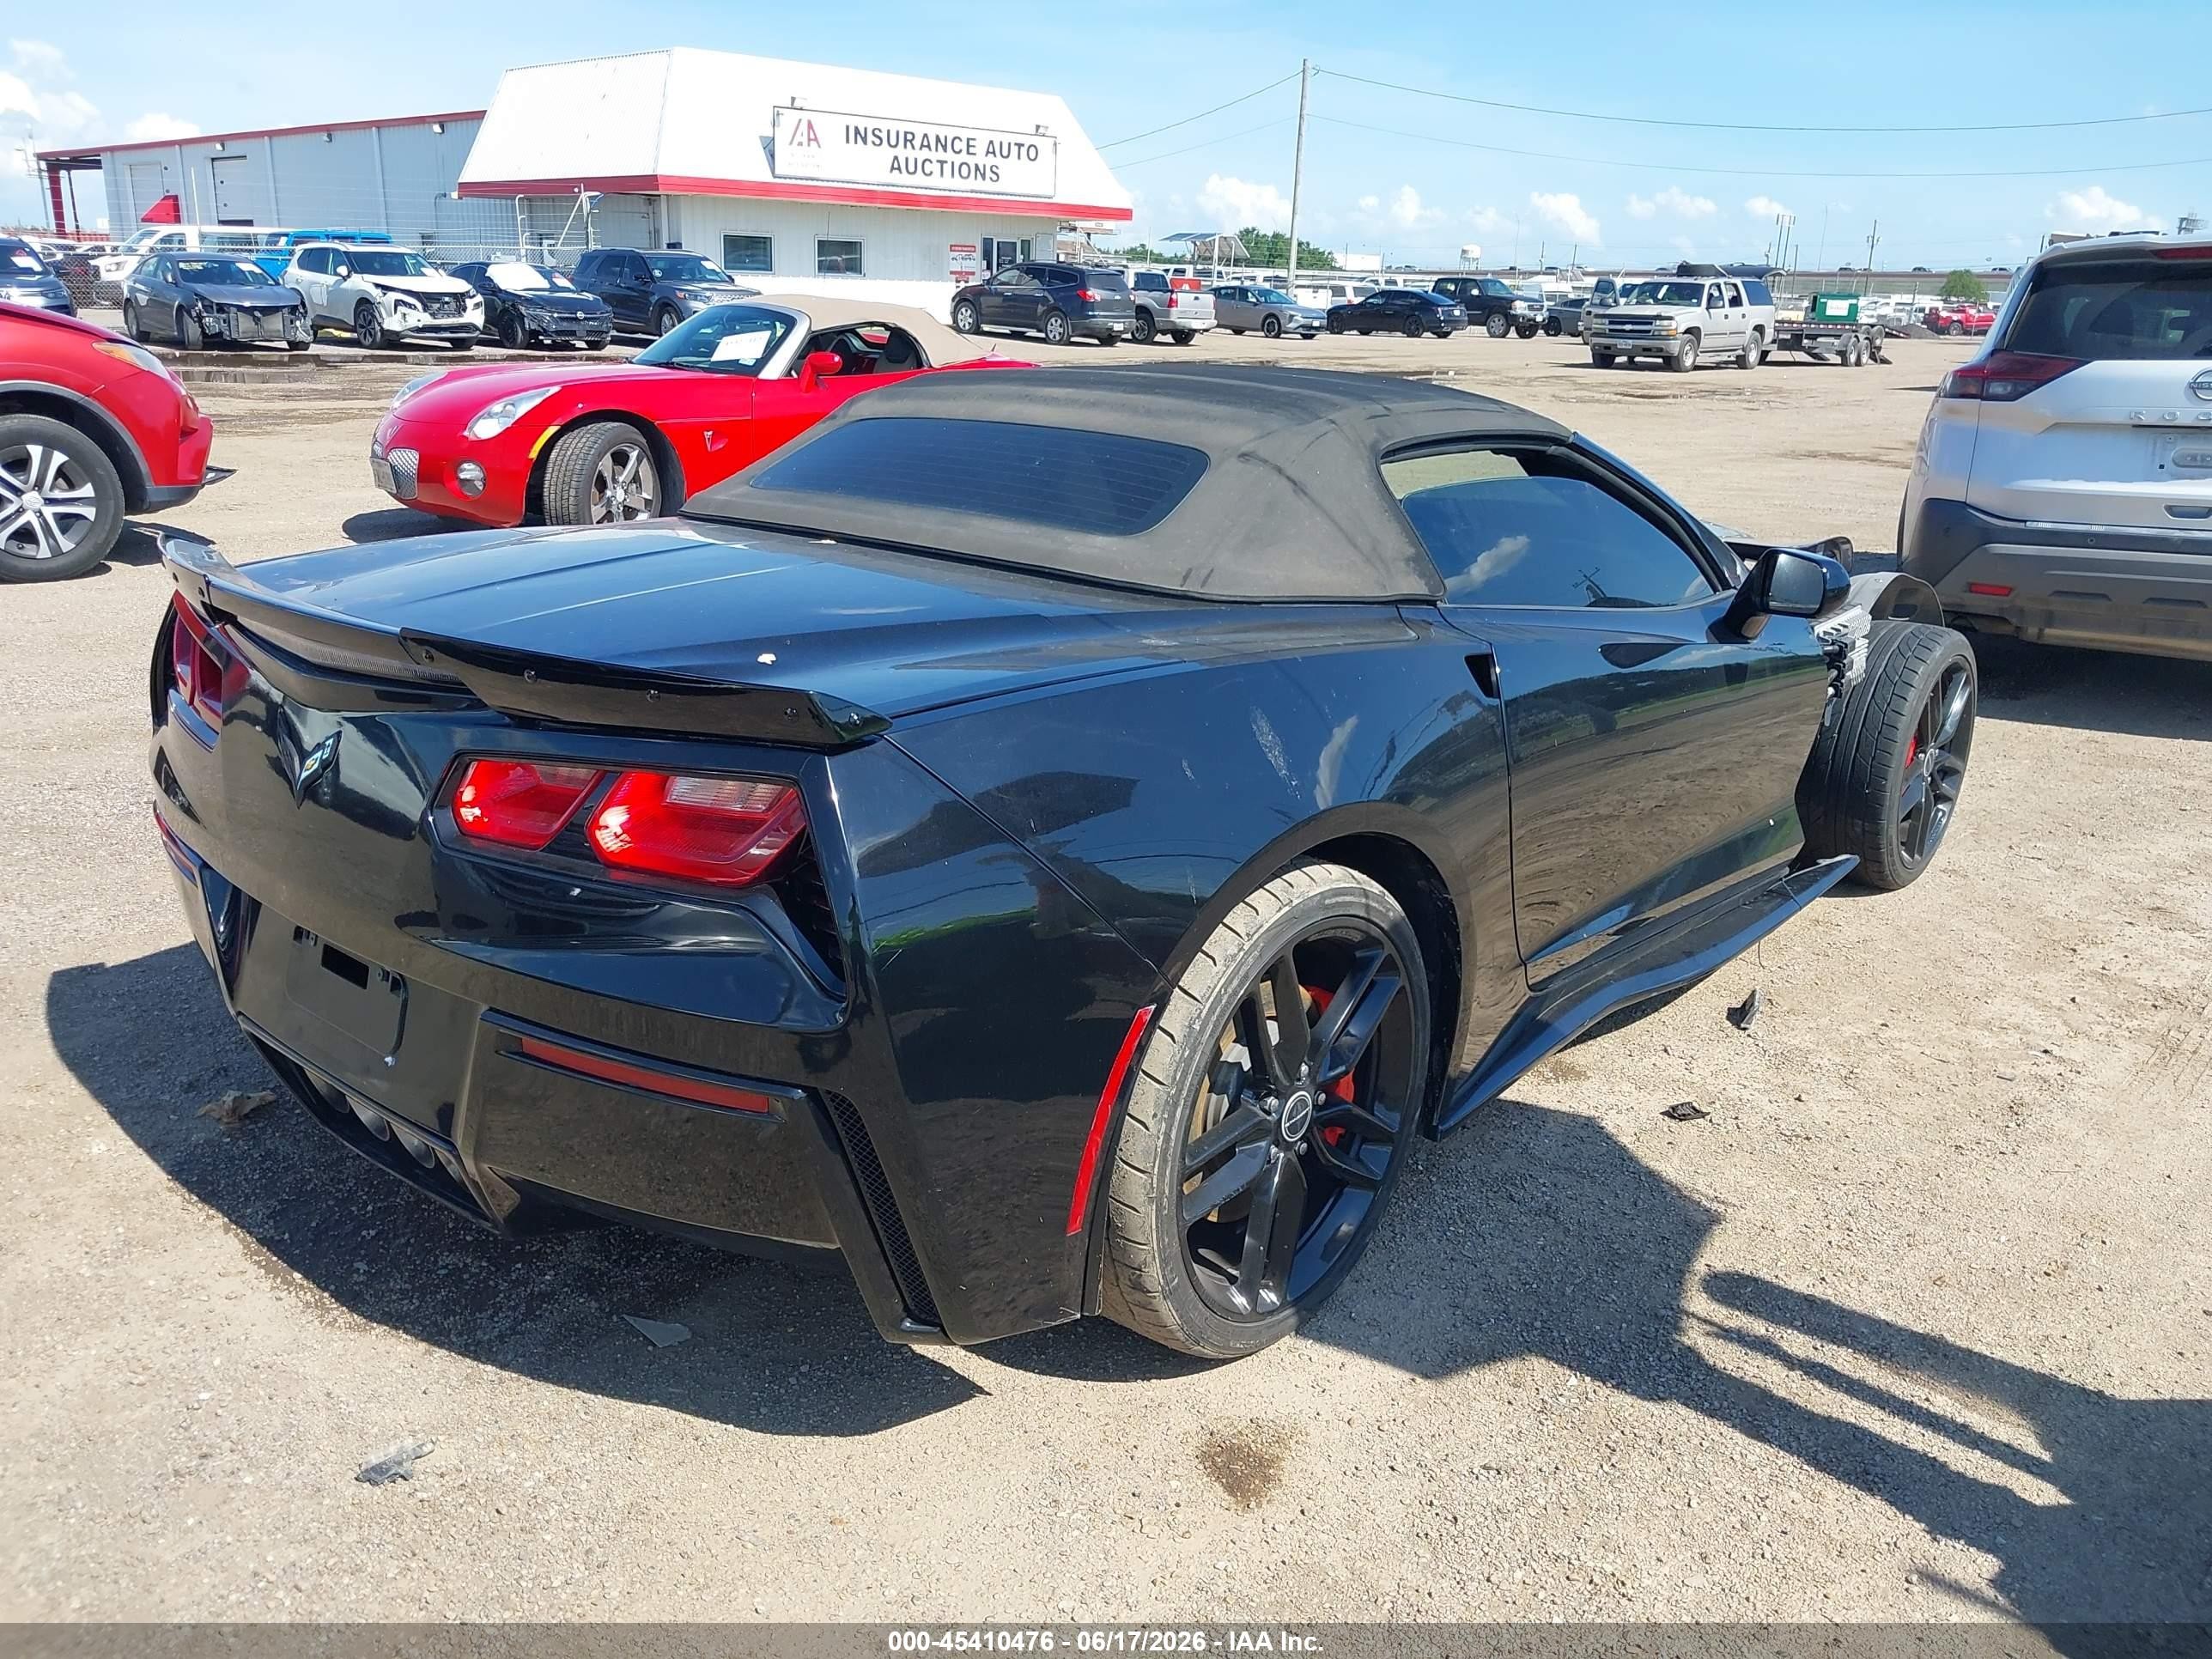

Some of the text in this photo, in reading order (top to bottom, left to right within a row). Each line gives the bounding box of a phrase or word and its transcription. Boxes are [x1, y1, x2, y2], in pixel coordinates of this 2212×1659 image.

[845, 125, 1040, 162] INSURANCE AUTO
[890, 156, 1001, 183] AUCTIONS
